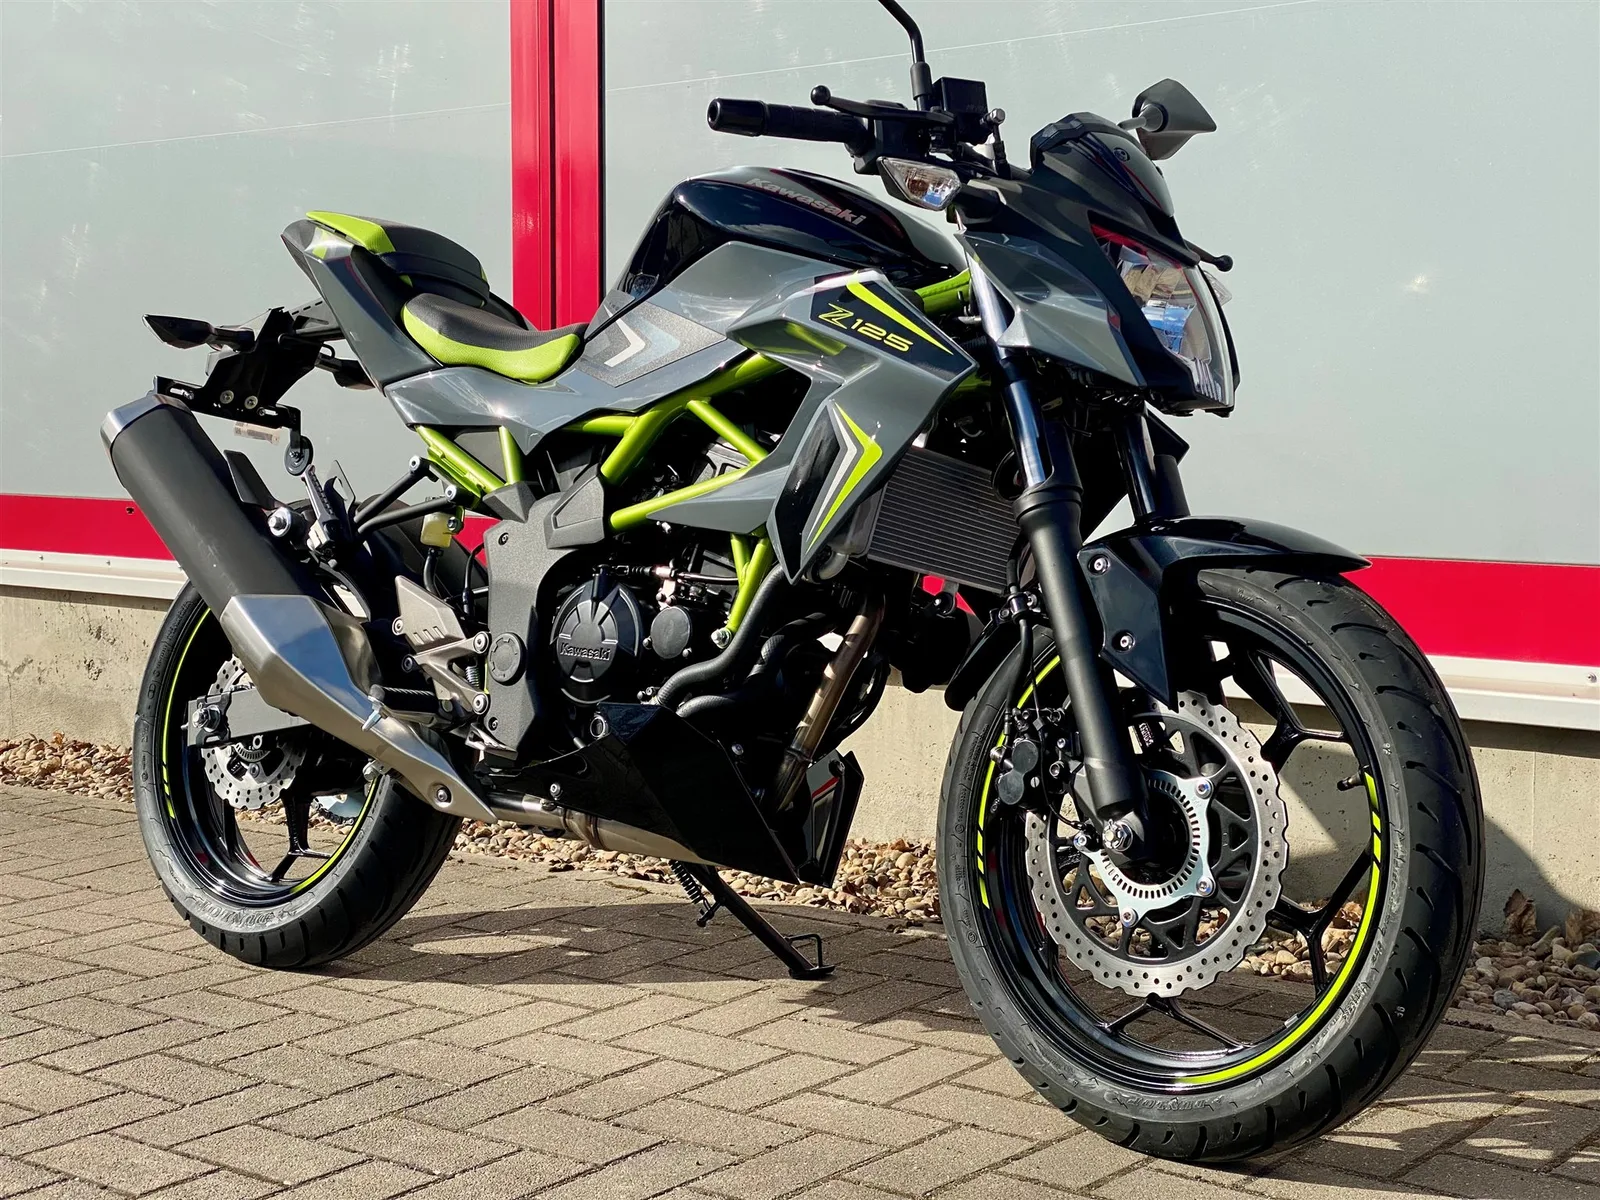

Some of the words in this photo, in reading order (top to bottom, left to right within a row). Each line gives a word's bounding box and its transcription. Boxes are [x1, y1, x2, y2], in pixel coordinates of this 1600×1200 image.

[745, 178, 867, 226] Kawasaki
[818, 303, 913, 353] Z125
[560, 643, 612, 661] Kawasaki
